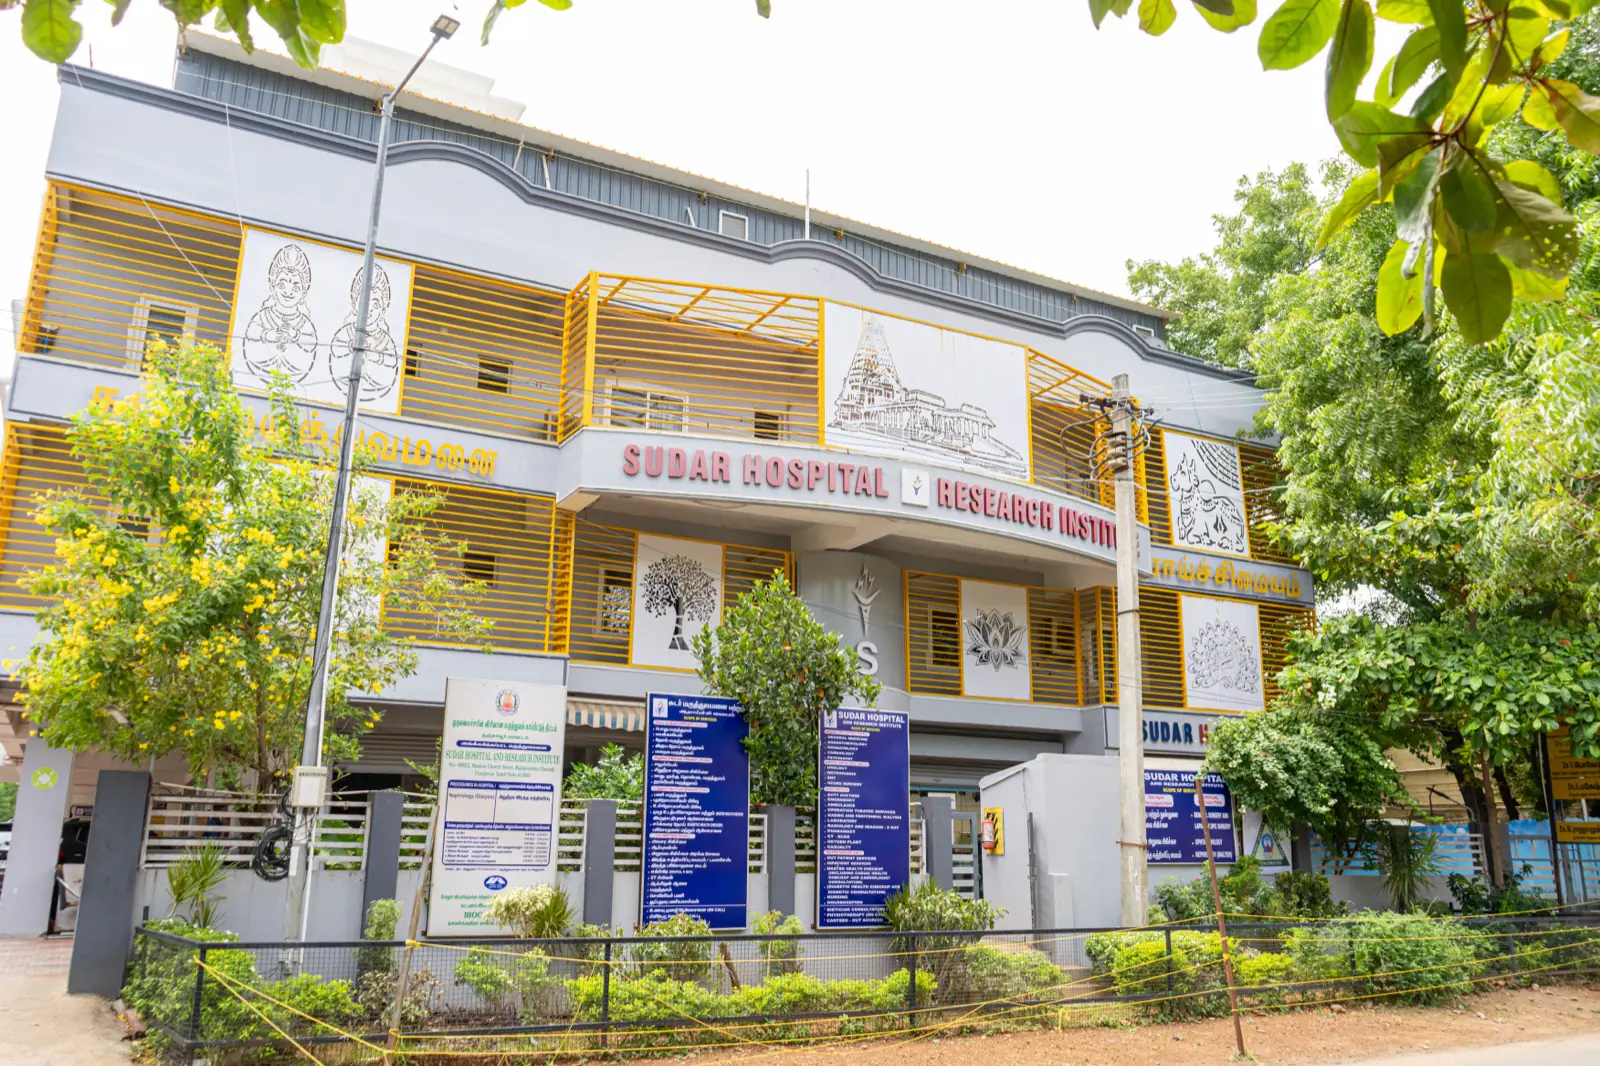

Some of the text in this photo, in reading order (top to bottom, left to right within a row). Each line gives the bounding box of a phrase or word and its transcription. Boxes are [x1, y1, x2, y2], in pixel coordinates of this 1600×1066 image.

[622, 443, 889, 498] SUDAR HOSPITAL
[937, 477, 1140, 560] RESEARCH INSTIT
[857, 640, 879, 676] S
[838, 711, 905, 723] SUDAR HOSPITAL
[1142, 719, 1194, 745] SUDAR
[446, 750, 560, 765] SUDAR HOSPITAL AND RESEARCH INSTITUTE
[1144, 772, 1227, 783] SUDAR HOITAL
